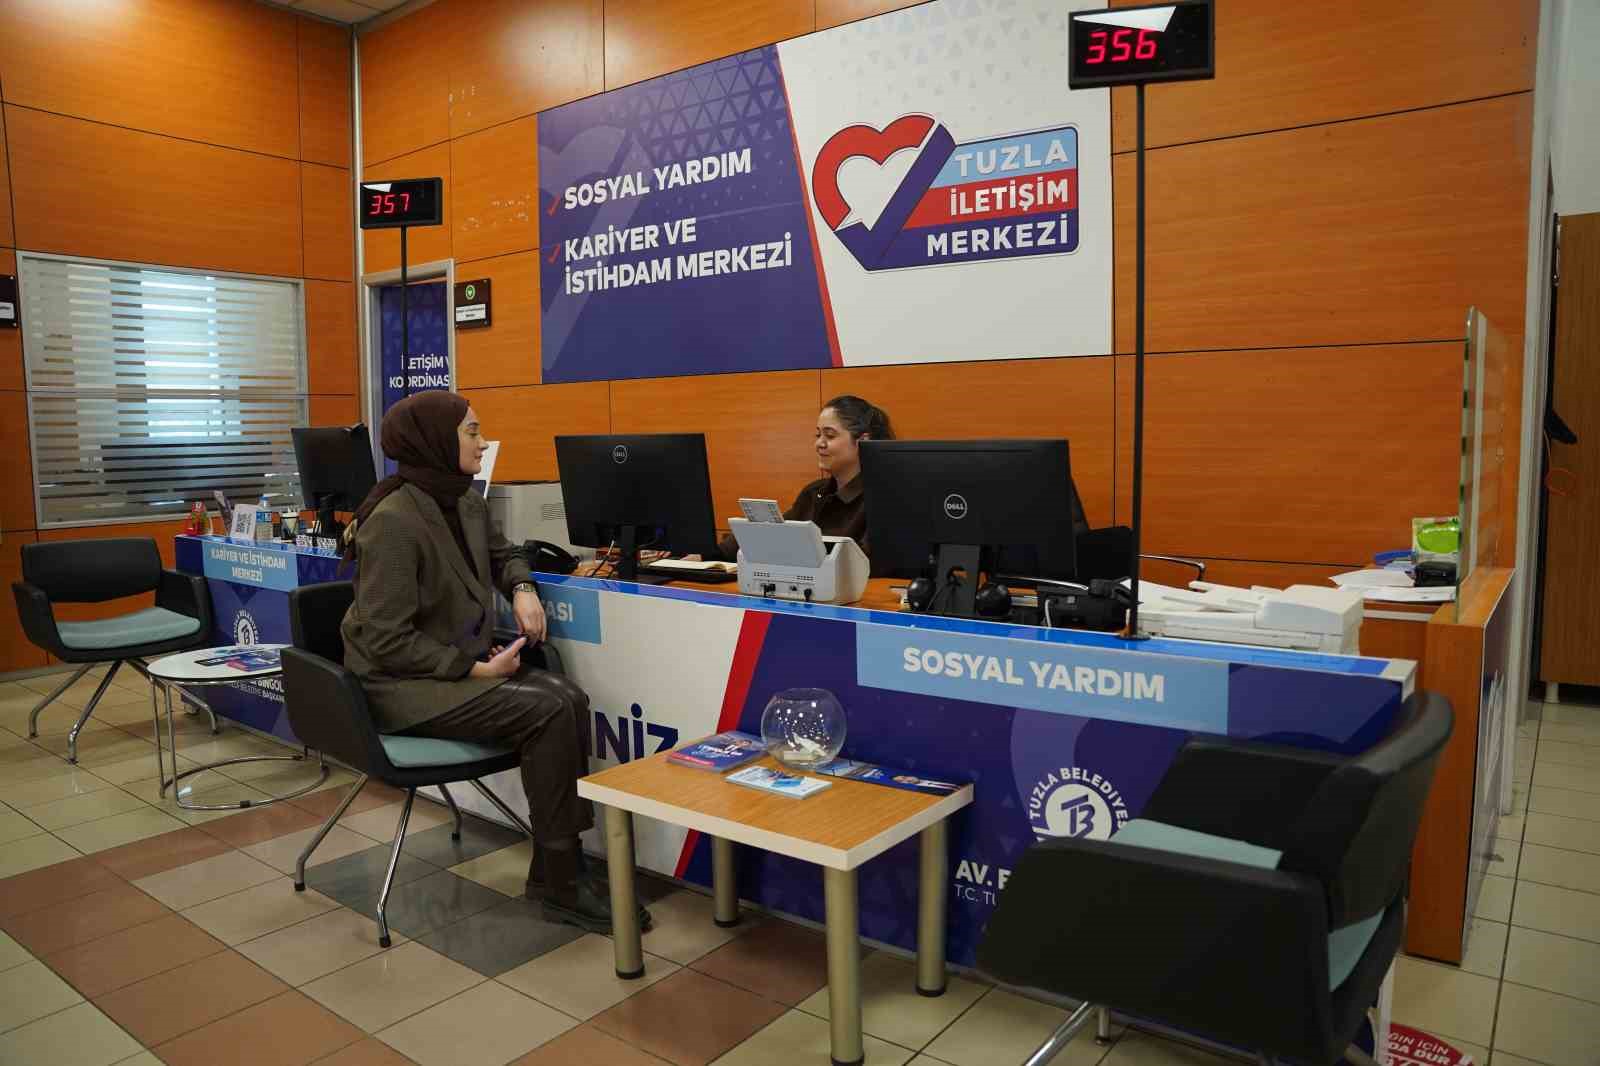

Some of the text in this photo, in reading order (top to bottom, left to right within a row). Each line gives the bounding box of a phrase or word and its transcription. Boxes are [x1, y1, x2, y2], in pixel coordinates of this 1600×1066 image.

[1085, 27, 1158, 64] 356
[564, 148, 752, 210] SOSYAL YARDIM
[955, 139, 1068, 177] TUZLA
[369, 192, 410, 215] 357
[950, 176, 1068, 216] İLETİŞİM
[564, 217, 697, 262] KARİYER VE
[927, 213, 1068, 257] MERKEZİ
[564, 231, 792, 295] İSTİHDAM MERKEZİ
[903, 647, 1165, 703] SOSYAL YARDIM
[587, 702, 679, 764] NİZ
[1029, 773, 1059, 820] TUZLA
[953, 883, 978, 903] T.C.
[955, 860, 993, 887] AV.
